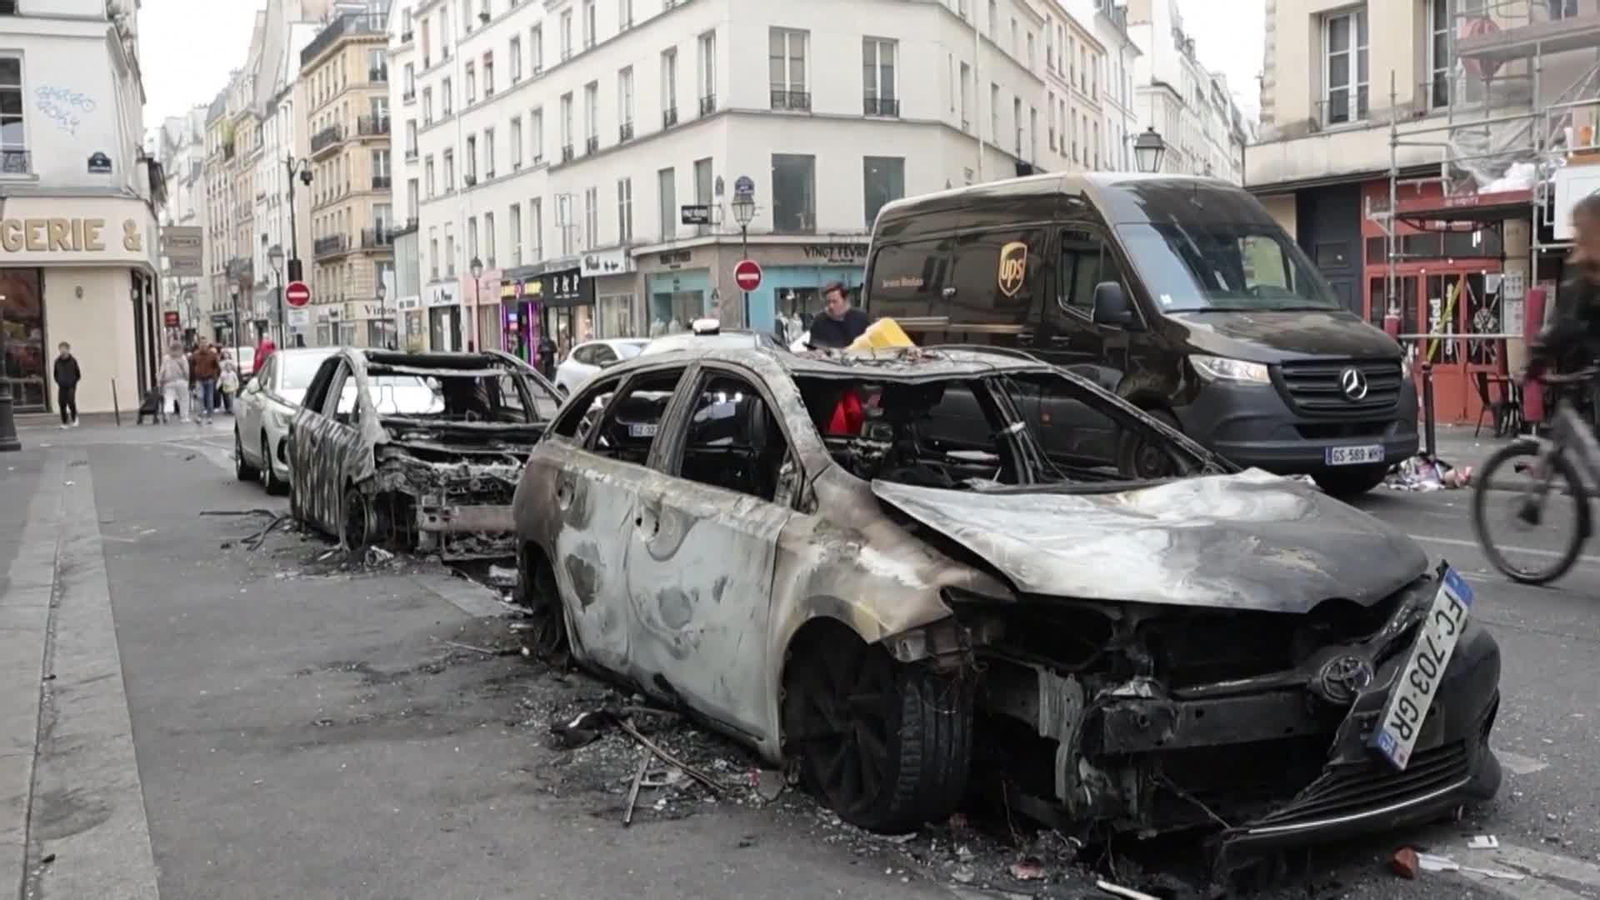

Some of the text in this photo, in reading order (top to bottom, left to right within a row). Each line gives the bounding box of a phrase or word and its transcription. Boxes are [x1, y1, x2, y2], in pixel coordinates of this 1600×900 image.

[0, 218, 142, 252] GERIE &
[1001, 258, 1024, 288] ups
